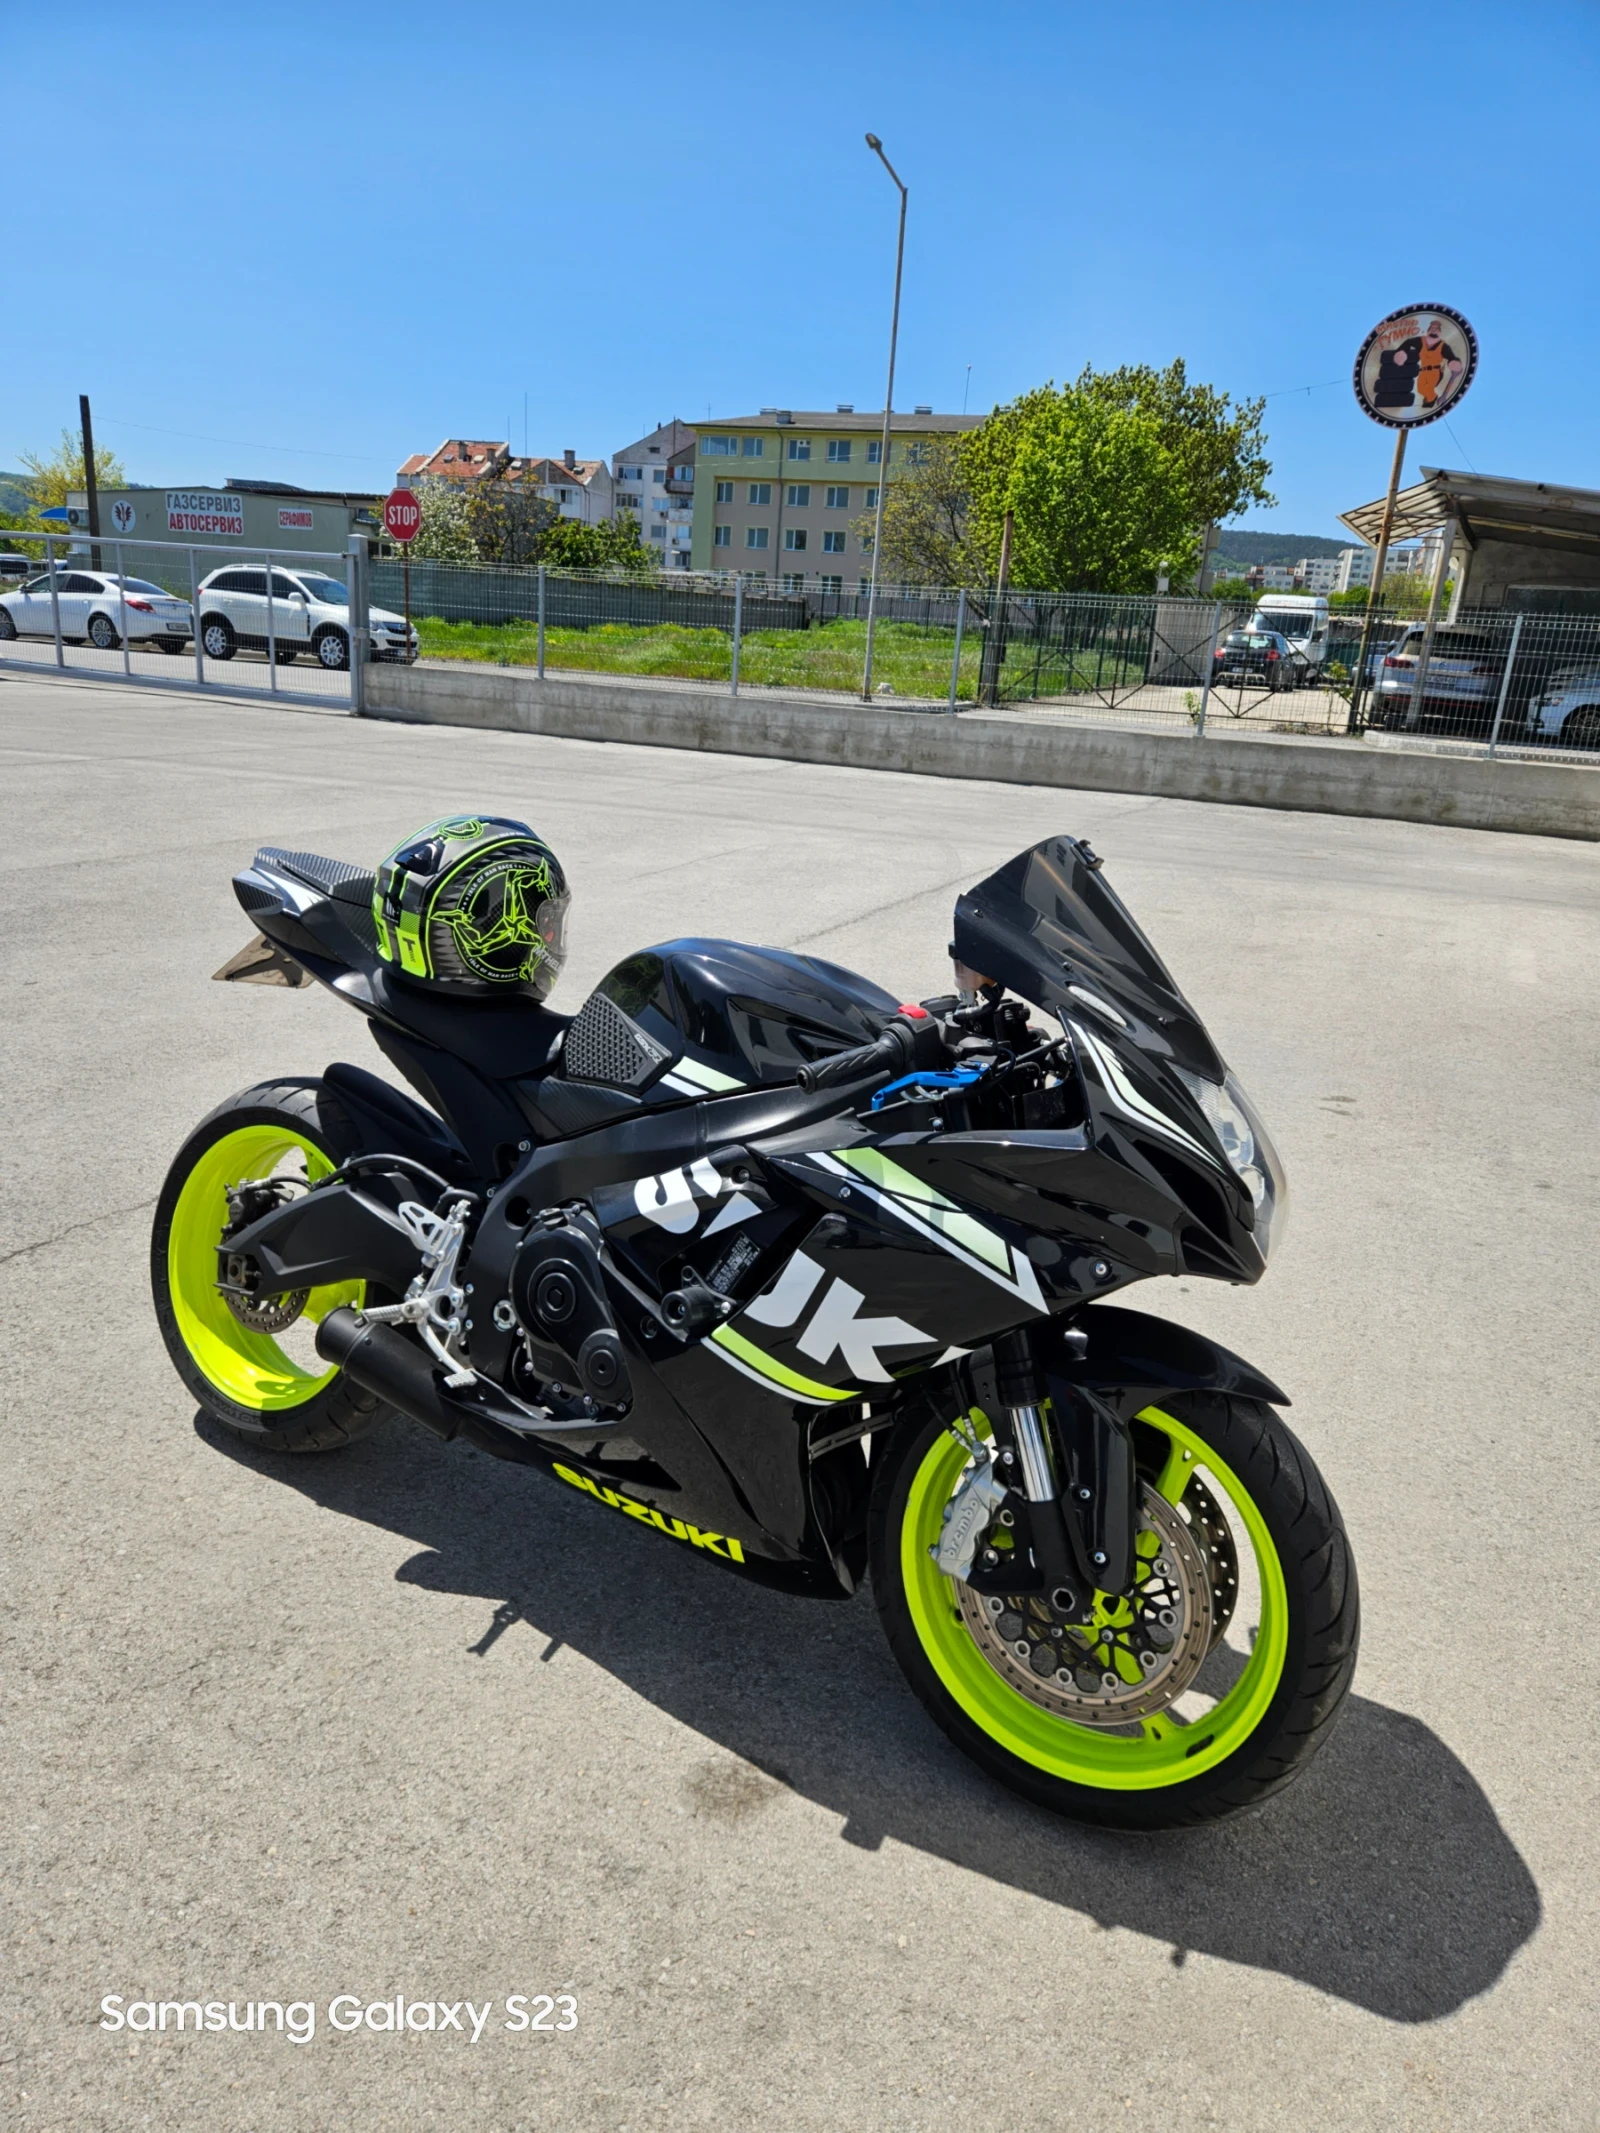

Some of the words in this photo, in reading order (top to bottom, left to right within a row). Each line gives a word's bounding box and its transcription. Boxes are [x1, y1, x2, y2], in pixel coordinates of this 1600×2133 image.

[166, 494, 241, 513] ГАЗСЕРВИЗ
[169, 512, 243, 534] АВТОСЕРВИЗ
[278, 510, 313, 528] СЕРАФИМОВ
[388, 505, 418, 526] STOP
[467, 882, 478, 896] ISLE
[484, 867, 497, 878] MAN
[497, 863, 513, 871] RACE
[468, 957, 480, 969] ISLE
[552, 1462, 745, 1563] SUZUKI
[944, 1498, 980, 1557] brembo
